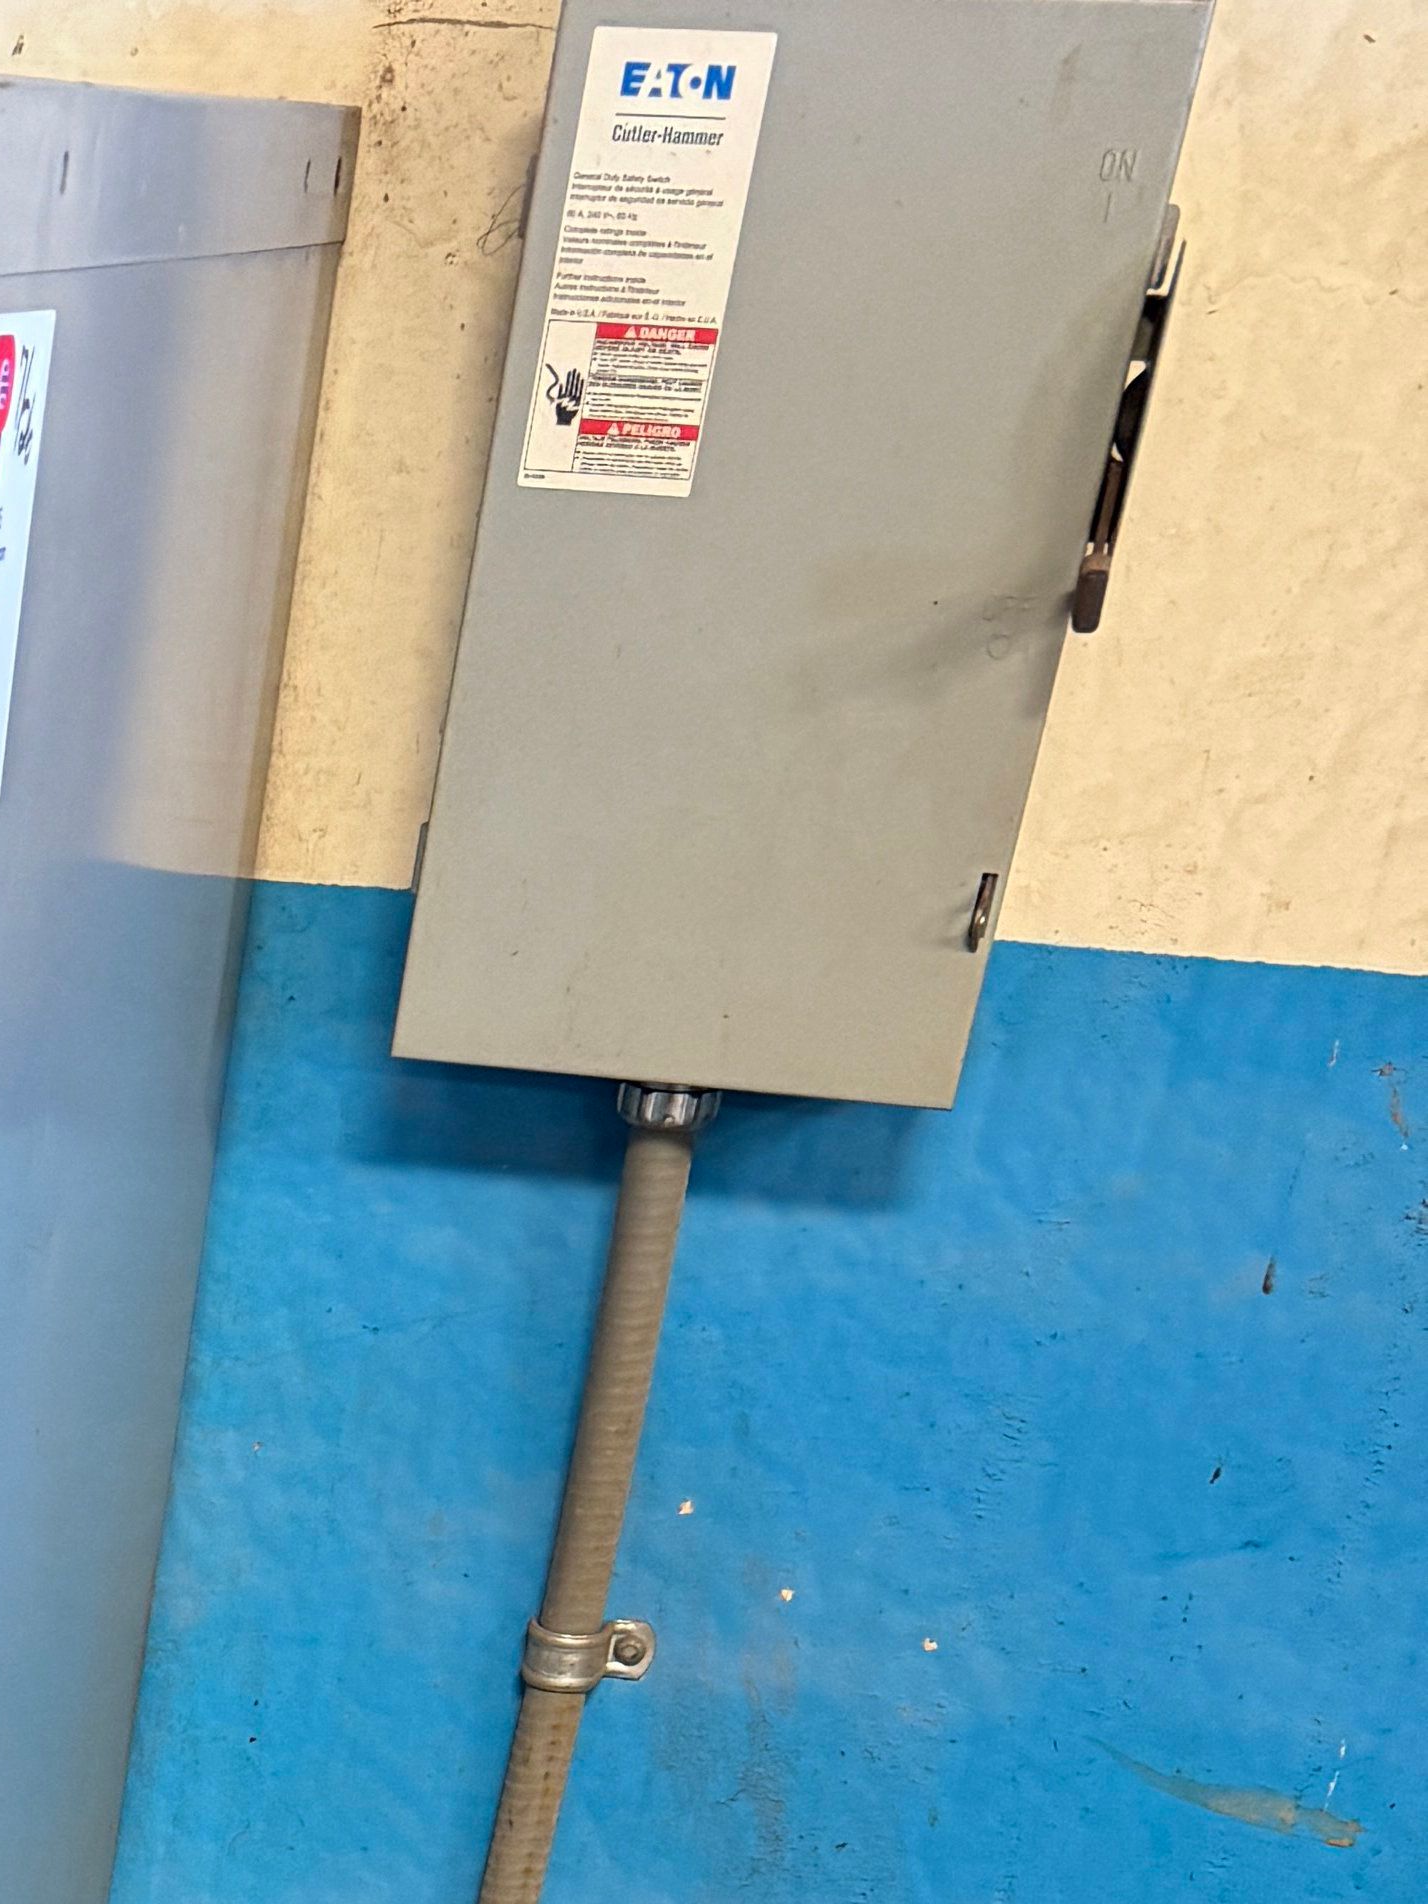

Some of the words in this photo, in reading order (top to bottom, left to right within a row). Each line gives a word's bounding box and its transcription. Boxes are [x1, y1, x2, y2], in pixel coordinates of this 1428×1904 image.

[620, 61, 737, 100] EATON
[612, 124, 724, 146] Cutler-Hammer
[639, 326, 696, 341] DANGER
[622, 424, 682, 438] PELIGRO
